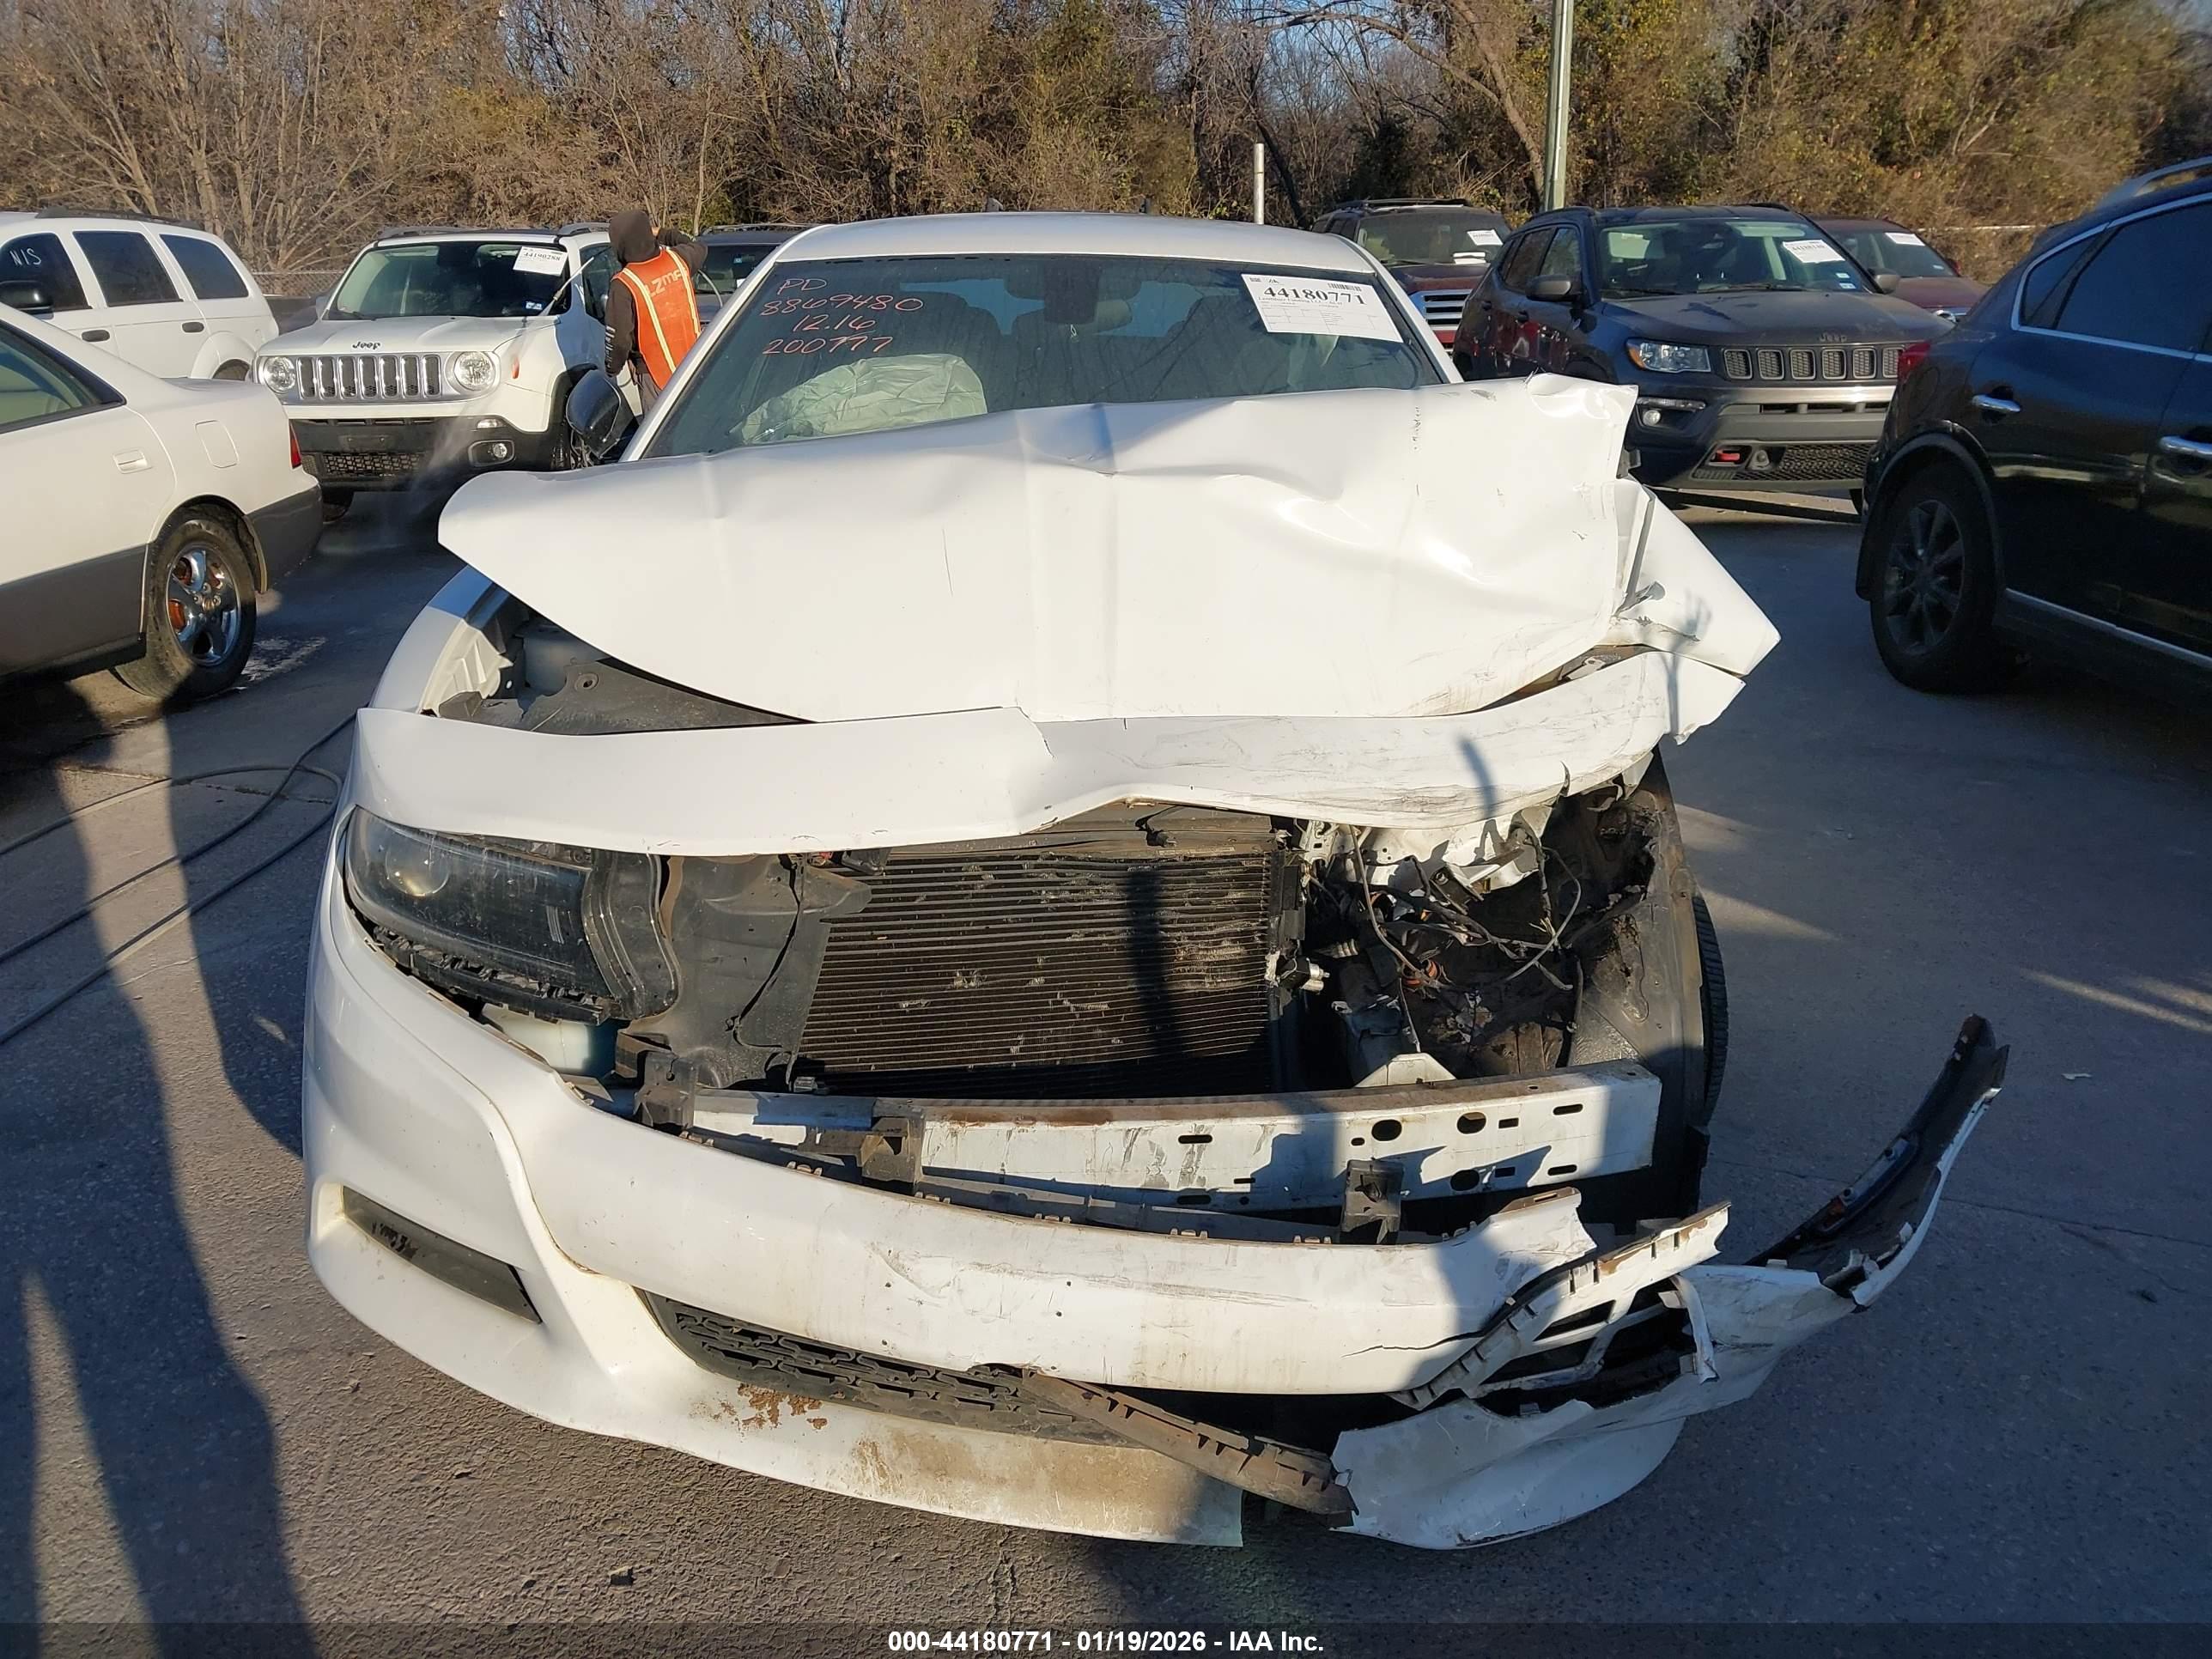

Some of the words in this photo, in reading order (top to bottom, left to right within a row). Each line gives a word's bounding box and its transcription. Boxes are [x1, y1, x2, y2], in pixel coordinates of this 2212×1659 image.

[9, 247, 41, 265] NIS
[777, 277, 828, 295] PD
[760, 294, 924, 316] 8869480
[1263, 286, 1368, 306] 44180771
[352, 341, 381, 350] Jeep
